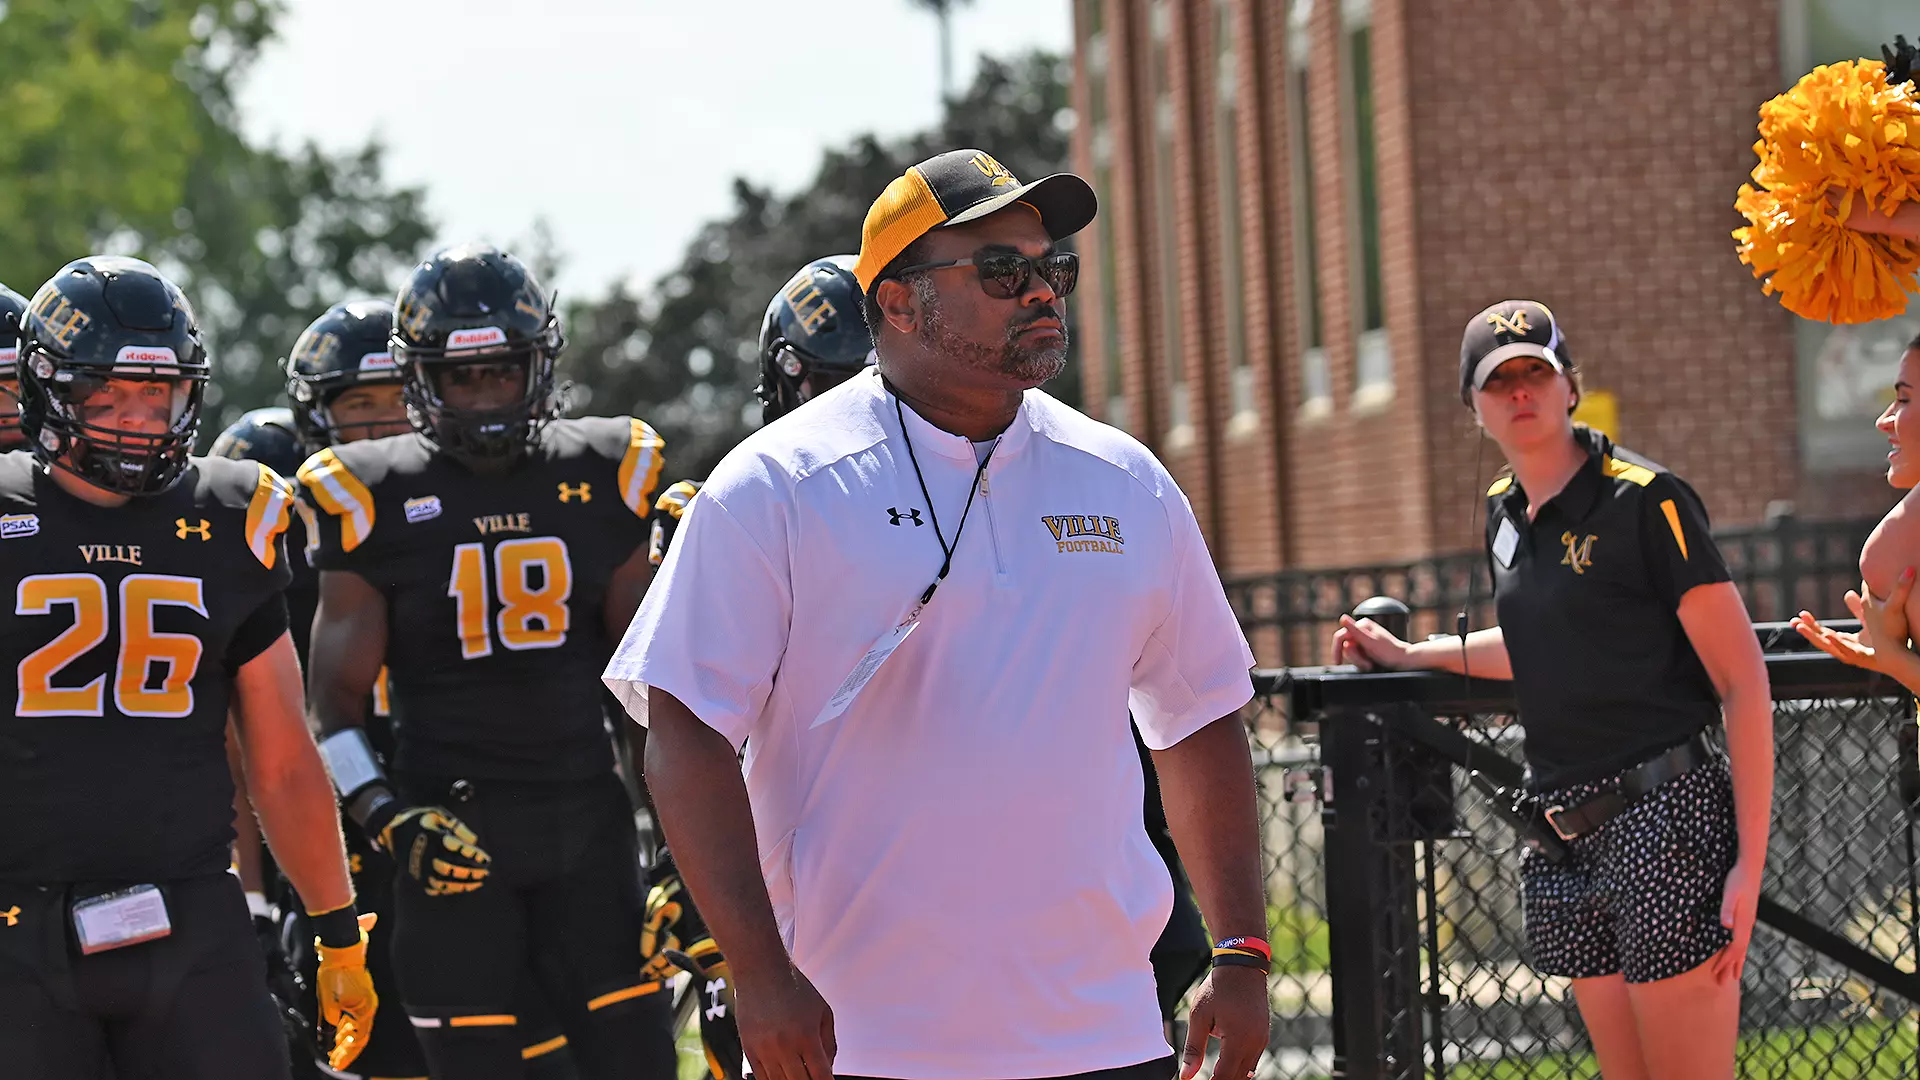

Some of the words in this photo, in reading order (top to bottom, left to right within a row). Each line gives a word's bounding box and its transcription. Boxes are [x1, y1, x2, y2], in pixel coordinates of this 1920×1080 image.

[30, 286, 91, 350] ILLE
[782, 273, 838, 337] ILLE
[1487, 309, 1532, 336] M
[2, 520, 35, 530] PSAC
[473, 512, 532, 536] VILLE
[1041, 515, 1125, 544] VILLE
[78, 544, 143, 566] VILLE
[1056, 540, 1125, 554] FOOTBALL
[1561, 530, 1599, 575] M
[447, 536, 573, 660] 18
[14, 572, 210, 718] 26
